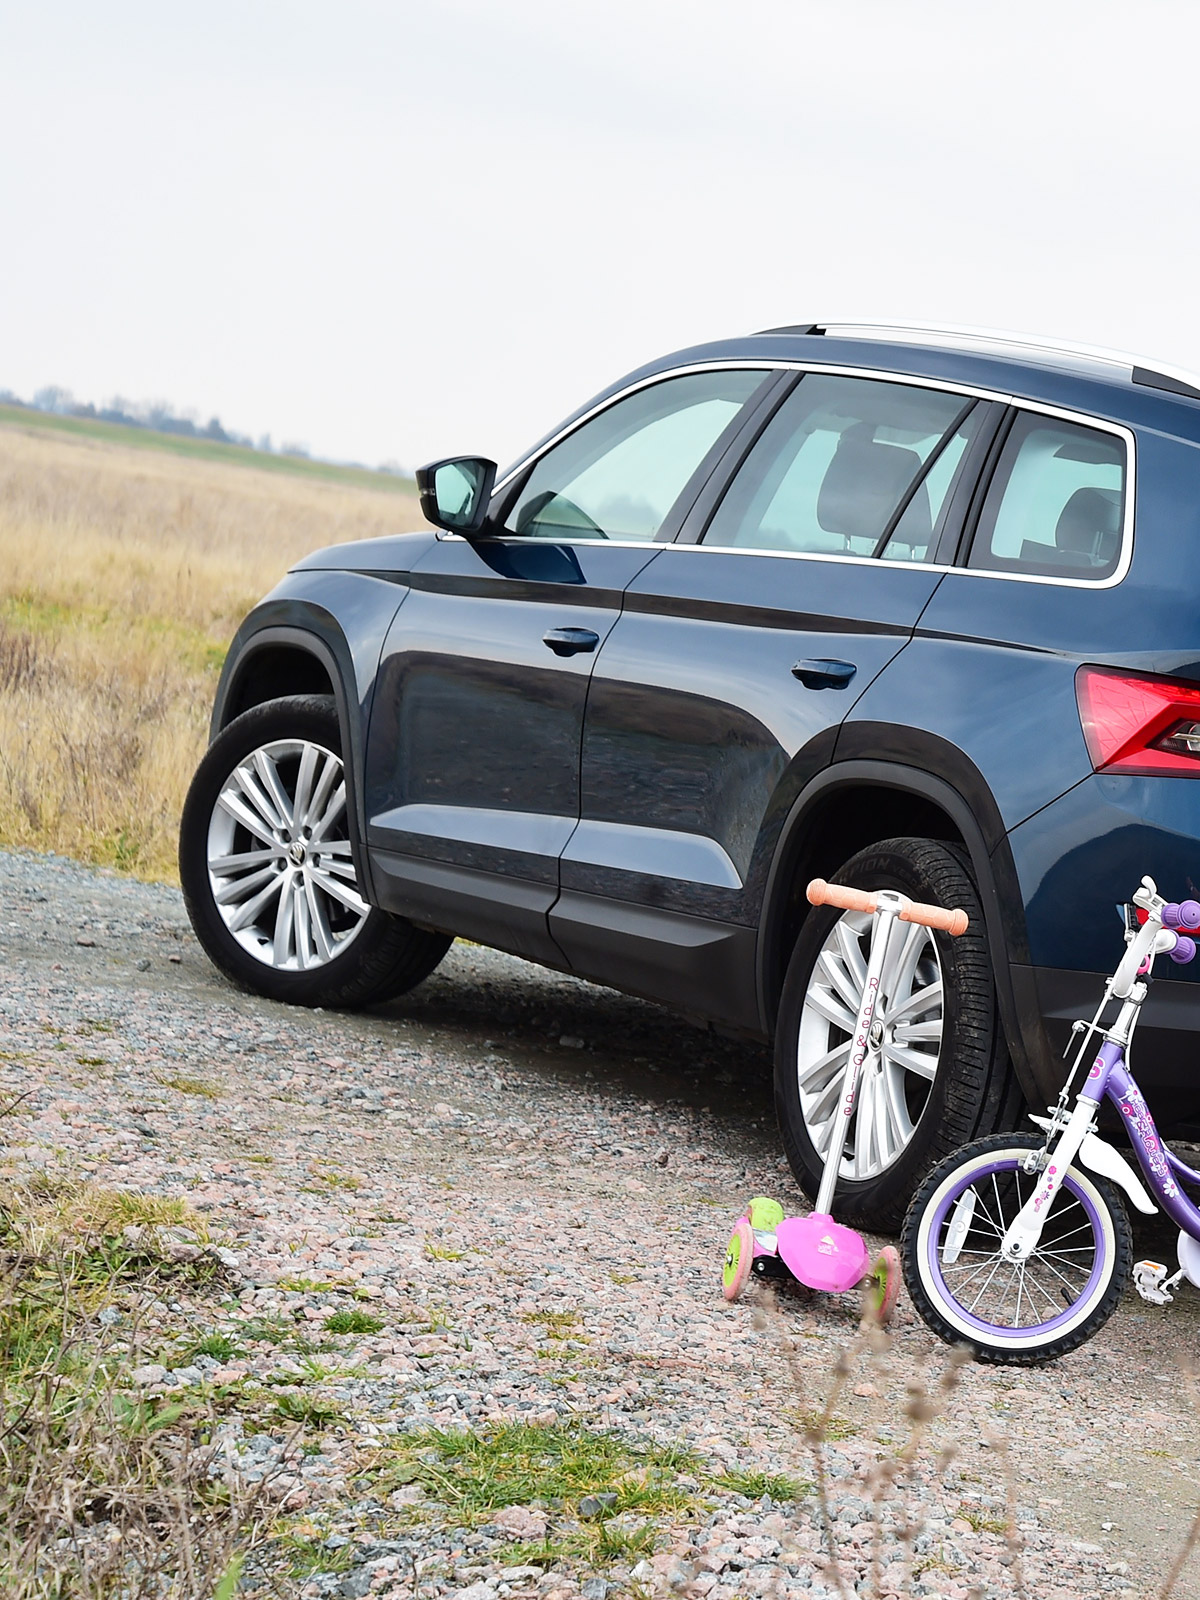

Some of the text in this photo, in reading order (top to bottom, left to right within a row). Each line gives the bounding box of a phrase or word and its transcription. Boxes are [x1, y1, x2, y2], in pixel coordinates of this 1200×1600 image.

[843, 976, 880, 1117] Ride & Glide
